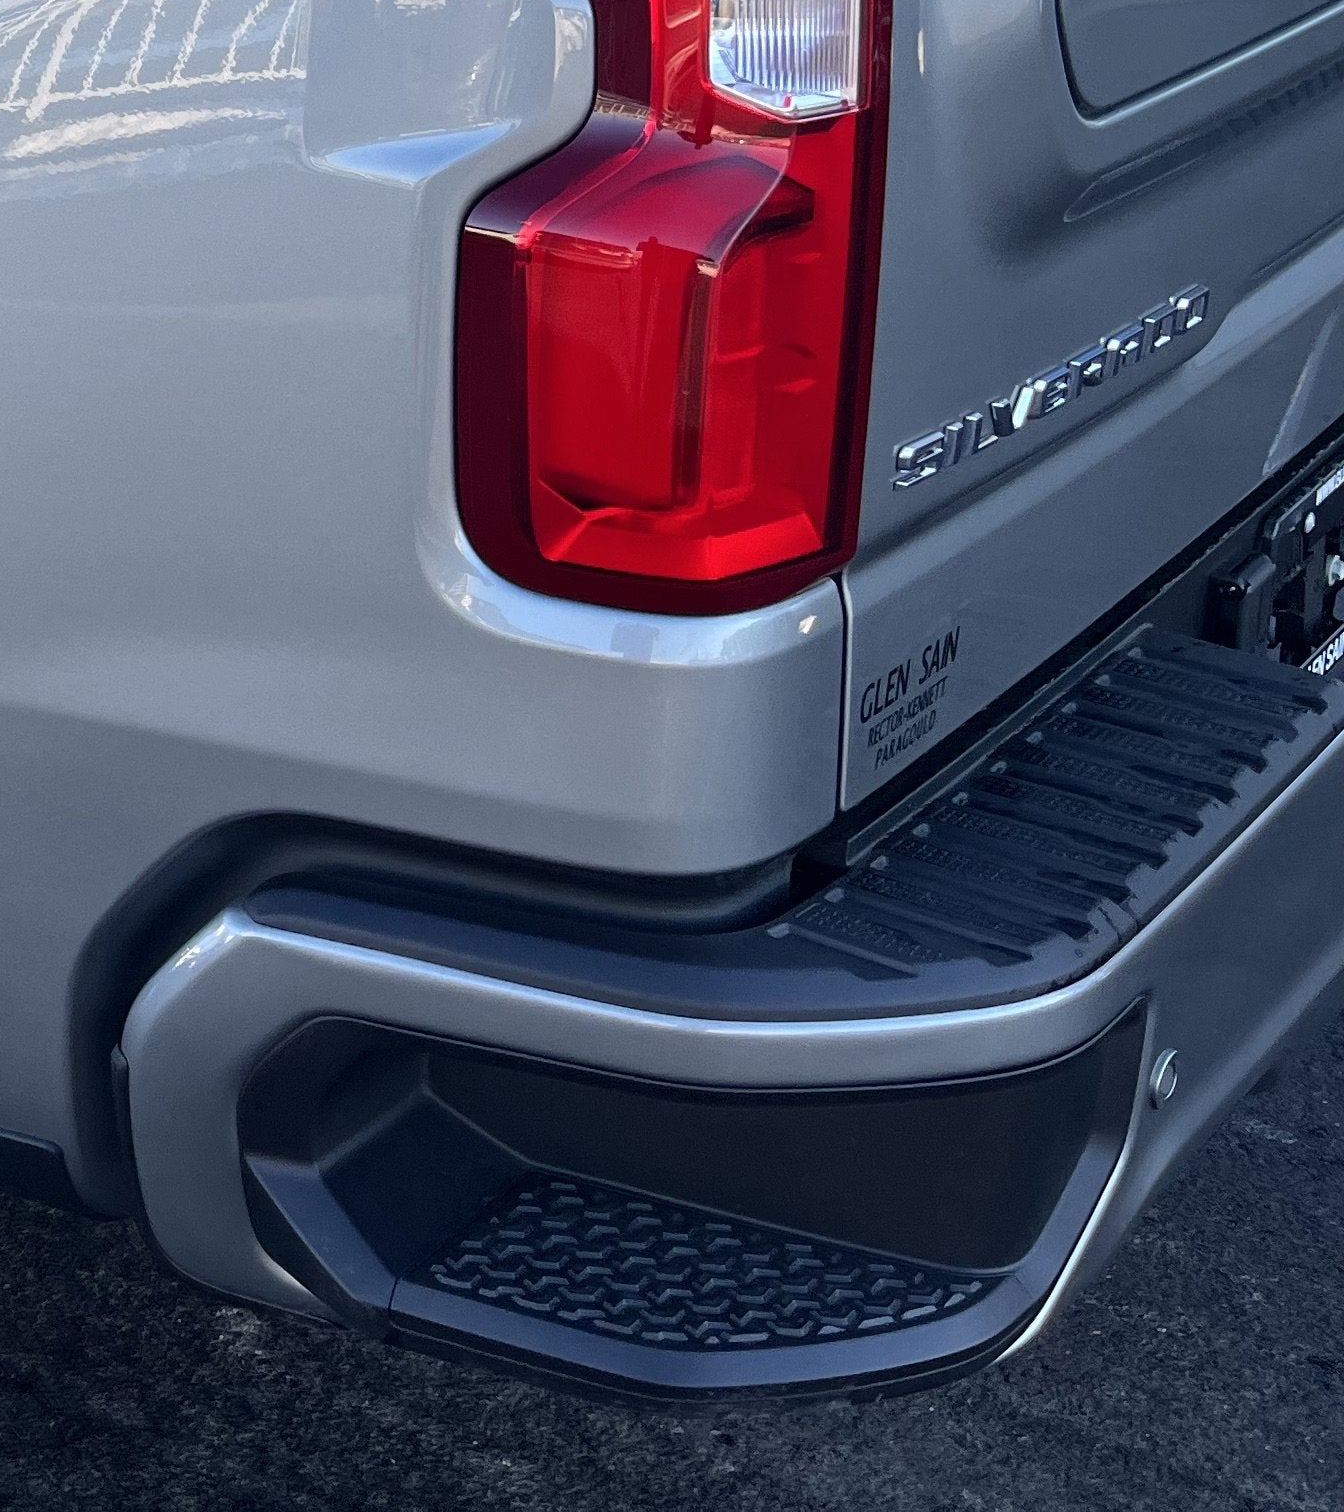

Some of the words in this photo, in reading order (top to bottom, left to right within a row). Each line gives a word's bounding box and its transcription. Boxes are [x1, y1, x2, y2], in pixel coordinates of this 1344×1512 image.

[890, 283, 1210, 491] SILVERADO
[861, 659, 911, 723] GLEN
[919, 626, 960, 684] SAIN
[874, 709, 937, 770] PARAGOULD
